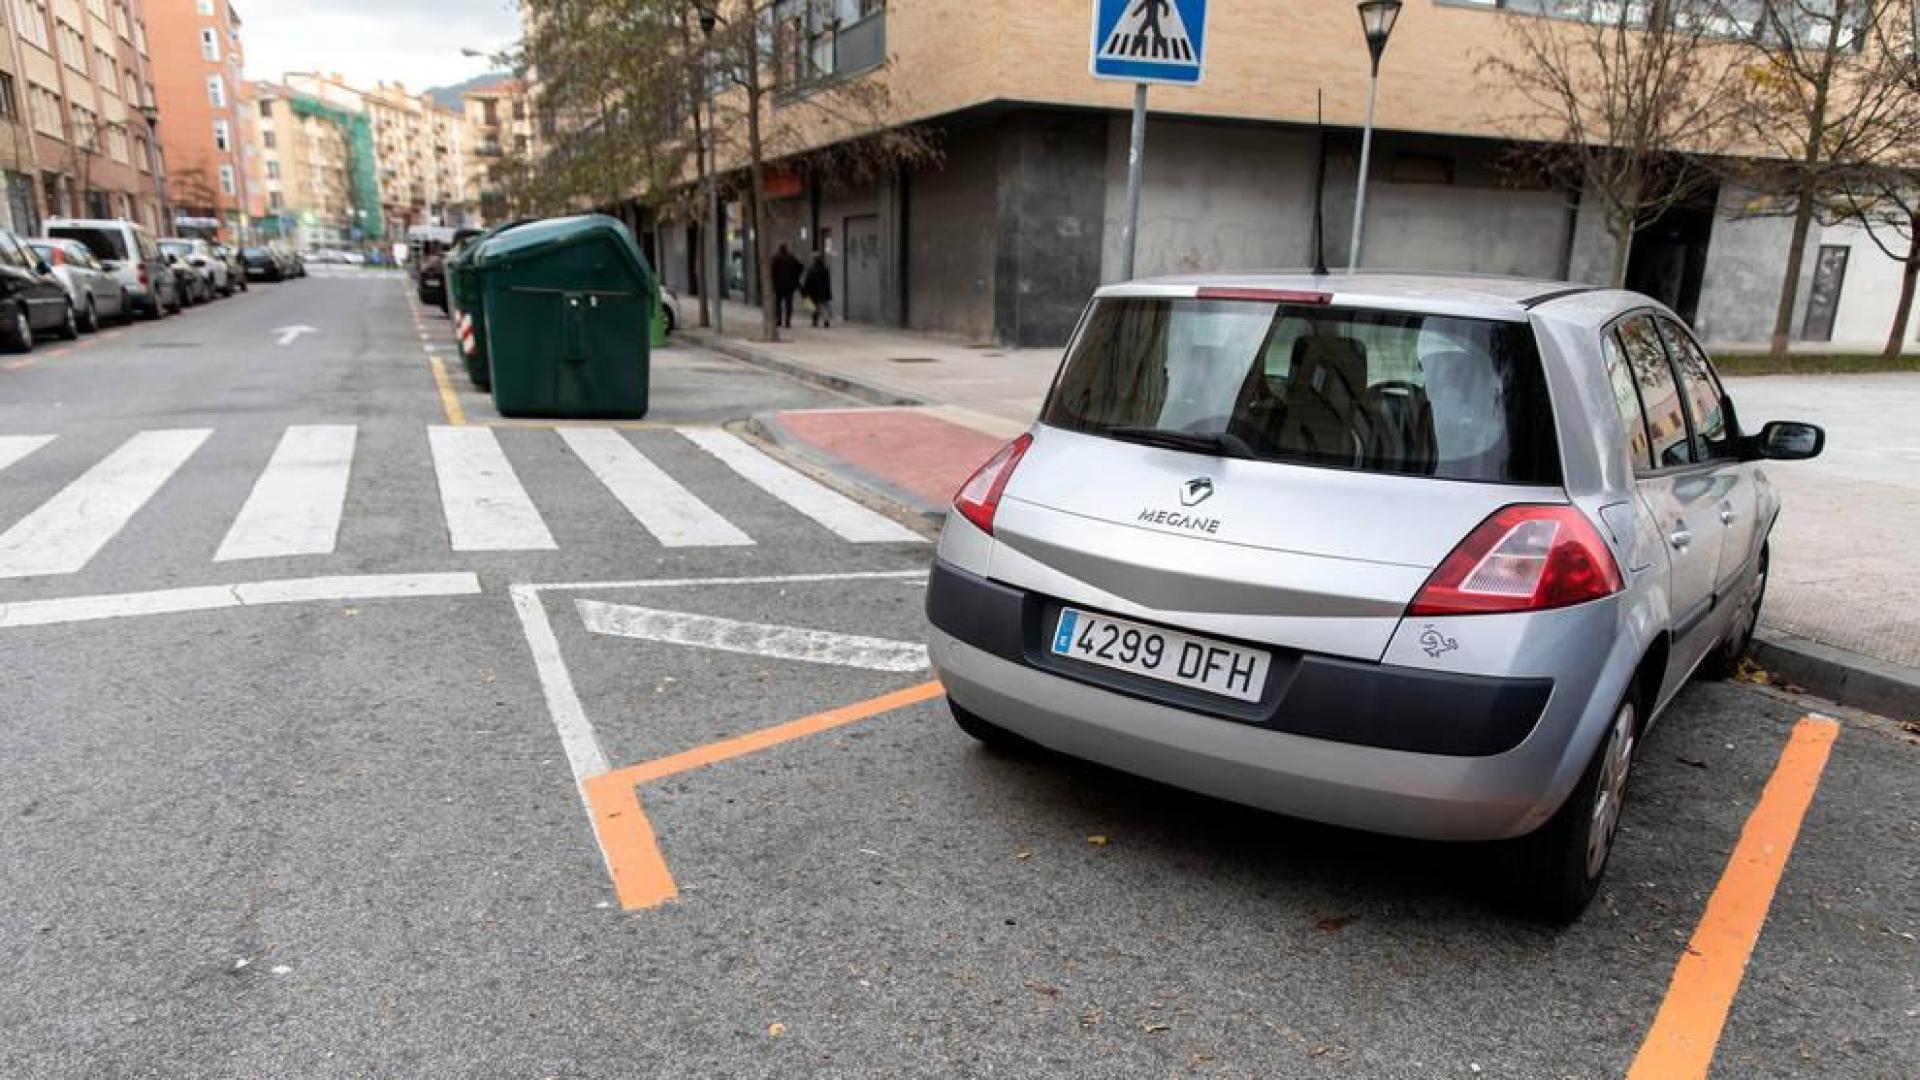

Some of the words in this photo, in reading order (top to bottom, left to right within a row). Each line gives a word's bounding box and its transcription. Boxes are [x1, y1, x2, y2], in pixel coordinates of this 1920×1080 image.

[1138, 507, 1220, 533] MEGANE
[1077, 620, 1164, 669] 4299
[1177, 641, 1256, 692] DFH
